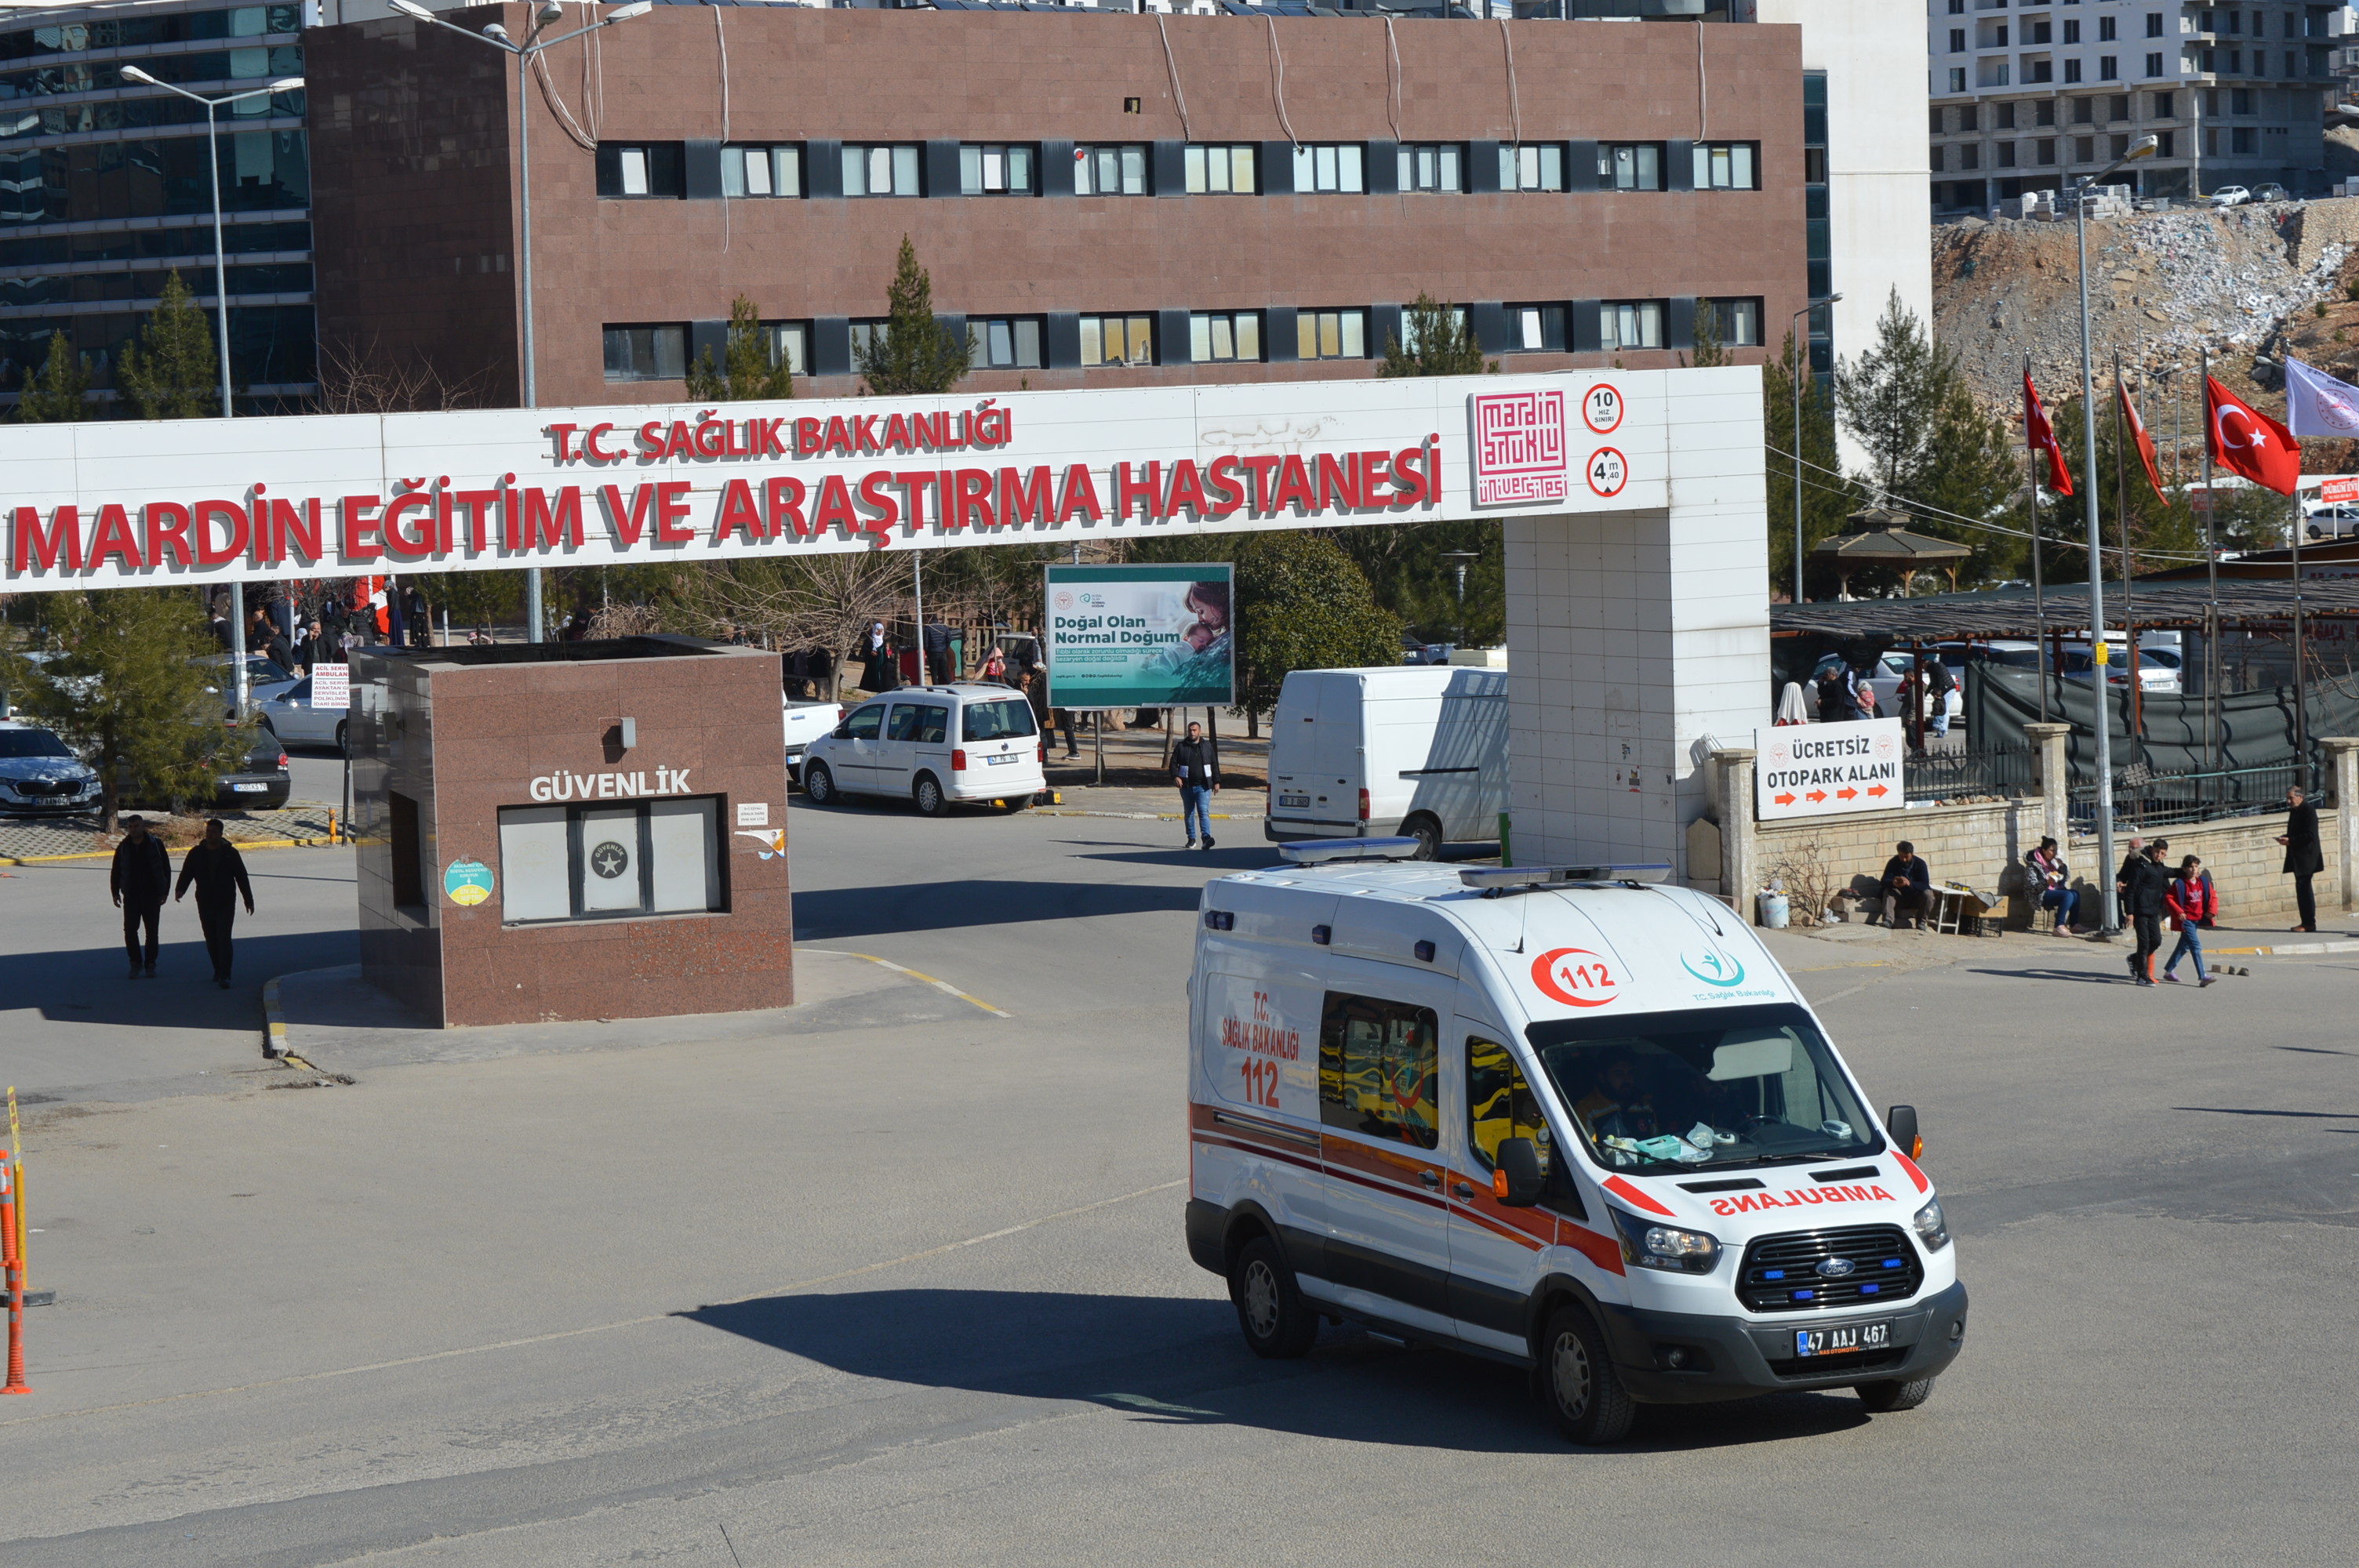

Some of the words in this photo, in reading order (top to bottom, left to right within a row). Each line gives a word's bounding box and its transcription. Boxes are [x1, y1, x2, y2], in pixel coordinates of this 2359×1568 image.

[1593, 391, 1613, 407] 10
[550, 423, 628, 460] T.C.
[642, 409, 786, 459] SAĞLIK
[798, 398, 1012, 453] BAKANLIĞI
[1594, 463, 1606, 480] 4
[13, 481, 322, 572] MARDİN
[343, 472, 584, 558] EĞİTİM
[602, 481, 695, 544] VE
[716, 464, 1103, 549] ARAŞTIRMA
[1118, 434, 1442, 519] HASTANESİ
[1055, 615, 1103, 631] Doğal
[1107, 615, 1146, 628] Olan
[1055, 630, 1115, 644] Normal
[1121, 630, 1180, 646] Doğum
[1793, 735, 1870, 759] ÜCRETSİZ
[529, 765, 692, 801] GÜVENLİK
[1768, 767, 1844, 788] OTOPARK
[1848, 762, 1896, 782] ALANI
[595, 844, 624, 858] GÜVENLİK
[1560, 963, 1616, 989] 112
[1253, 991, 1269, 1020] T.C.
[1708, 991, 1735, 1000] Sağlık
[1736, 989, 1776, 998] Bakanlığı
[1222, 1016, 1250, 1051] SAĞLIK
[1252, 1025, 1299, 1061] BAKANLIĞI
[1241, 1056, 1279, 1109] 112
[1826, 1258, 1848, 1274] Ford
[1808, 1333, 1823, 1350] 47
[1832, 1328, 1856, 1348] AAJ
[1863, 1325, 1886, 1343] 467
